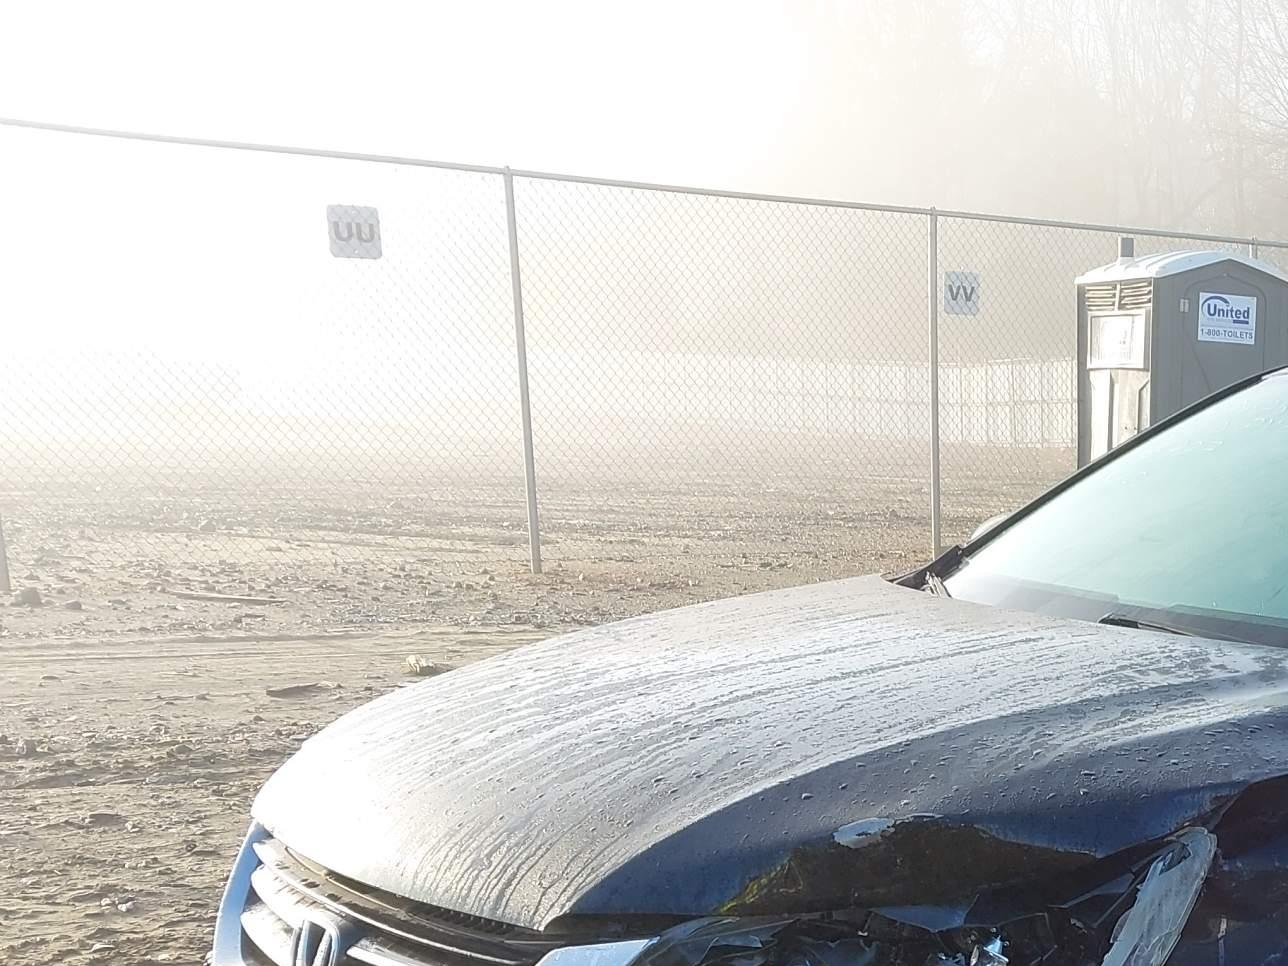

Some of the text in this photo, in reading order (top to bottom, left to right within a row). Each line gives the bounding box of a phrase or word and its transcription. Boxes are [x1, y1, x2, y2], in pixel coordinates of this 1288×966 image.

[332, 221, 375, 243] UU
[1207, 302, 1250, 320] United
[1201, 328, 1253, 340] 1-800-TOILETS
